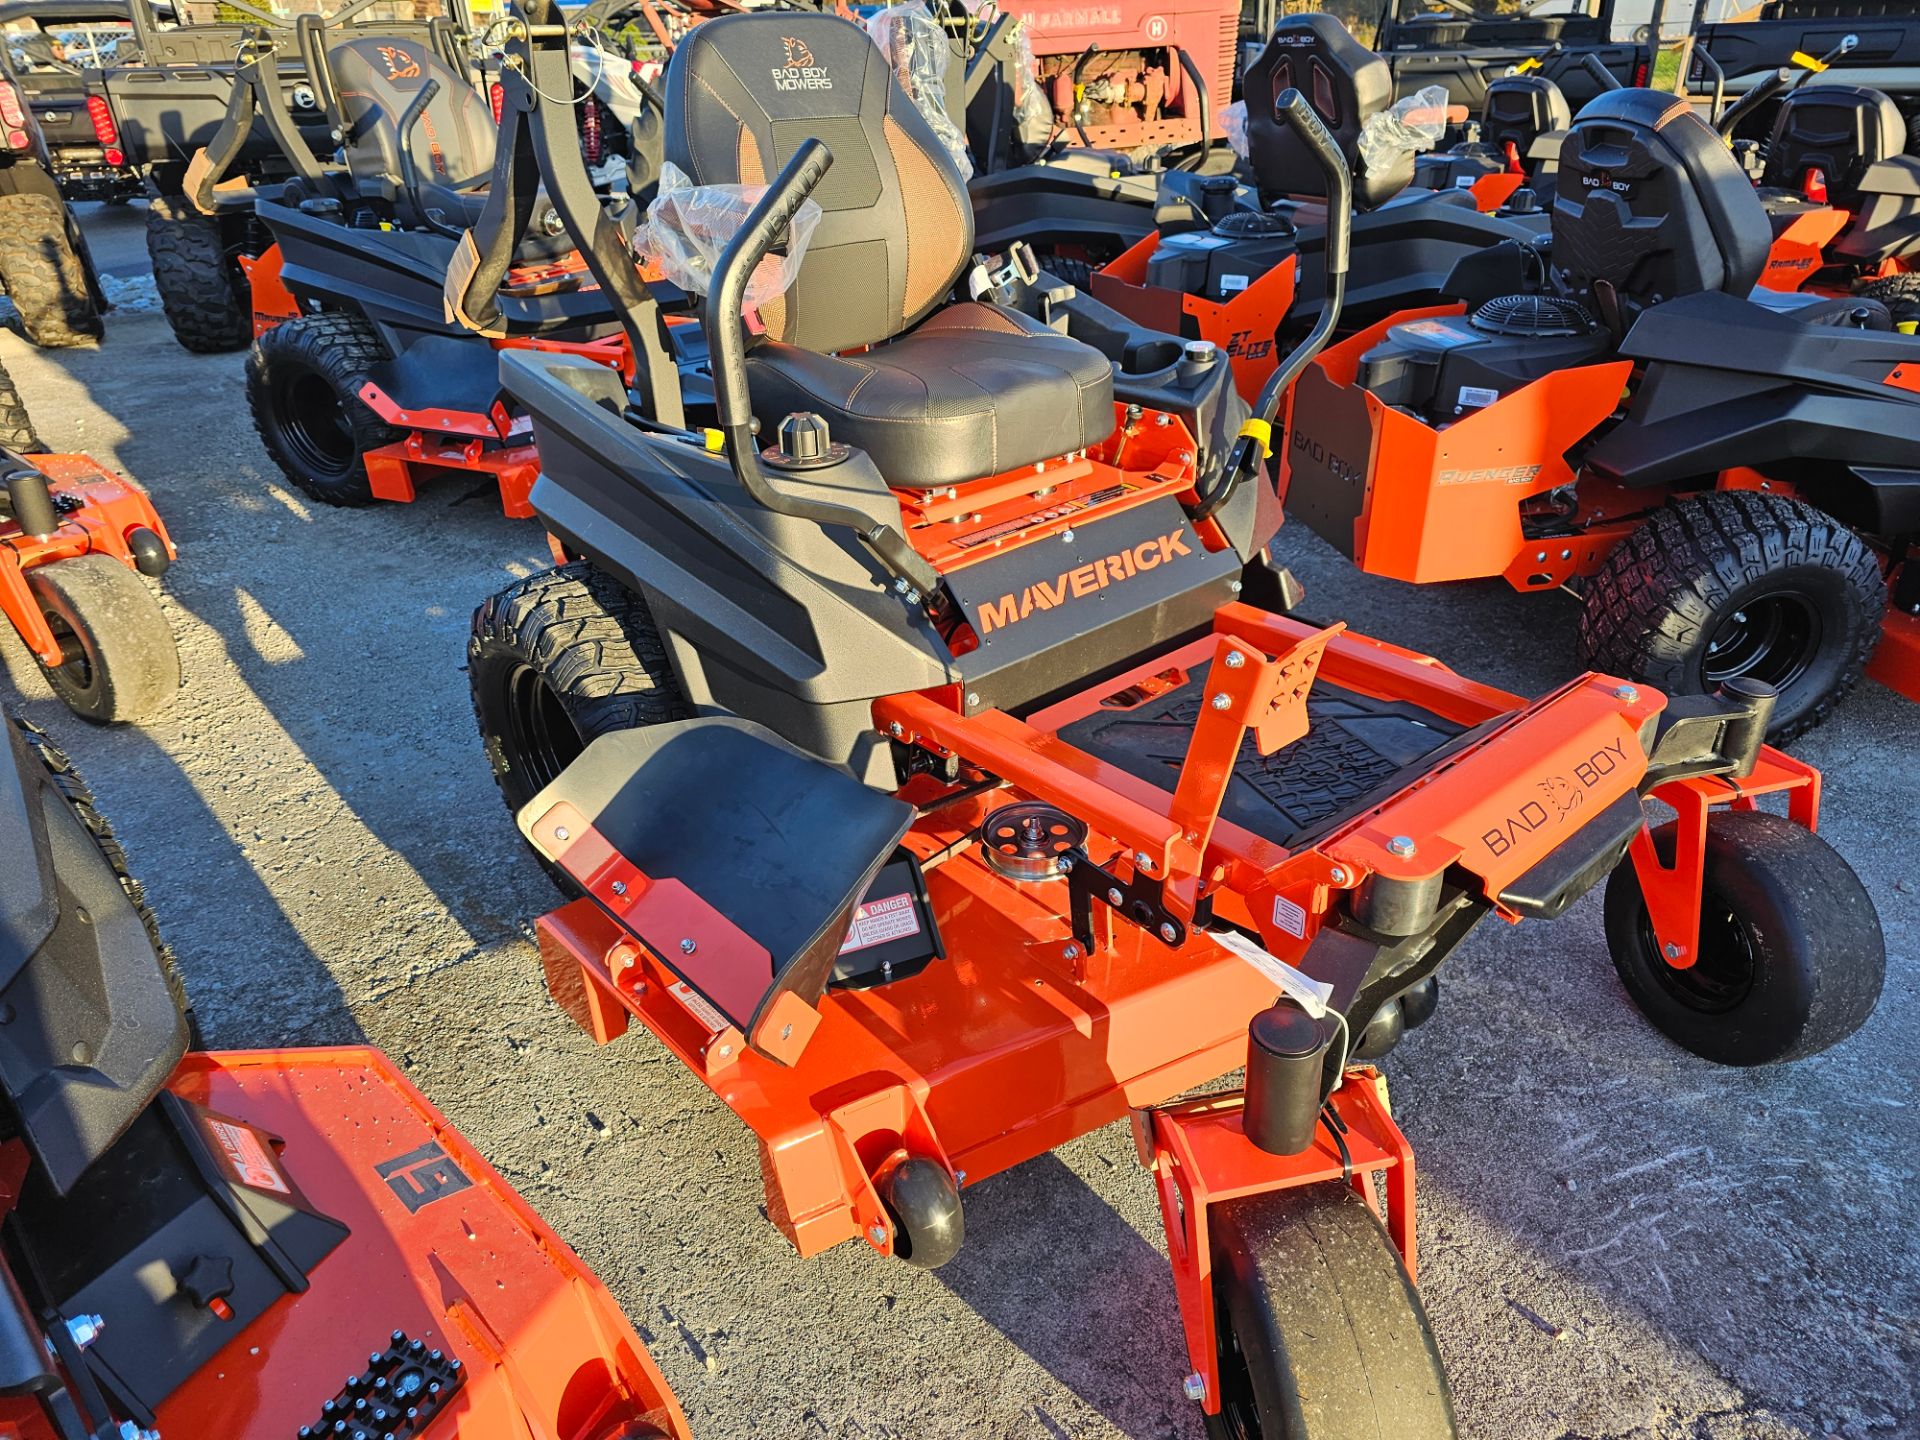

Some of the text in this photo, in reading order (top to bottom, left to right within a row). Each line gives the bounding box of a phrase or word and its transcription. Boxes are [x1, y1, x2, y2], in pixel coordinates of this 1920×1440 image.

[1039, 9, 1121, 28] FARMALL
[772, 67, 827, 79] BAD BOY
[774, 78, 832, 91] MOWERS
[1582, 176, 1630, 191] BAD BOY
[1294, 430, 1362, 487] BAD BOY
[977, 528, 1192, 634] MAVERICK
[1481, 737, 1627, 857] BAD BOY
[870, 897, 909, 914] DANGER
